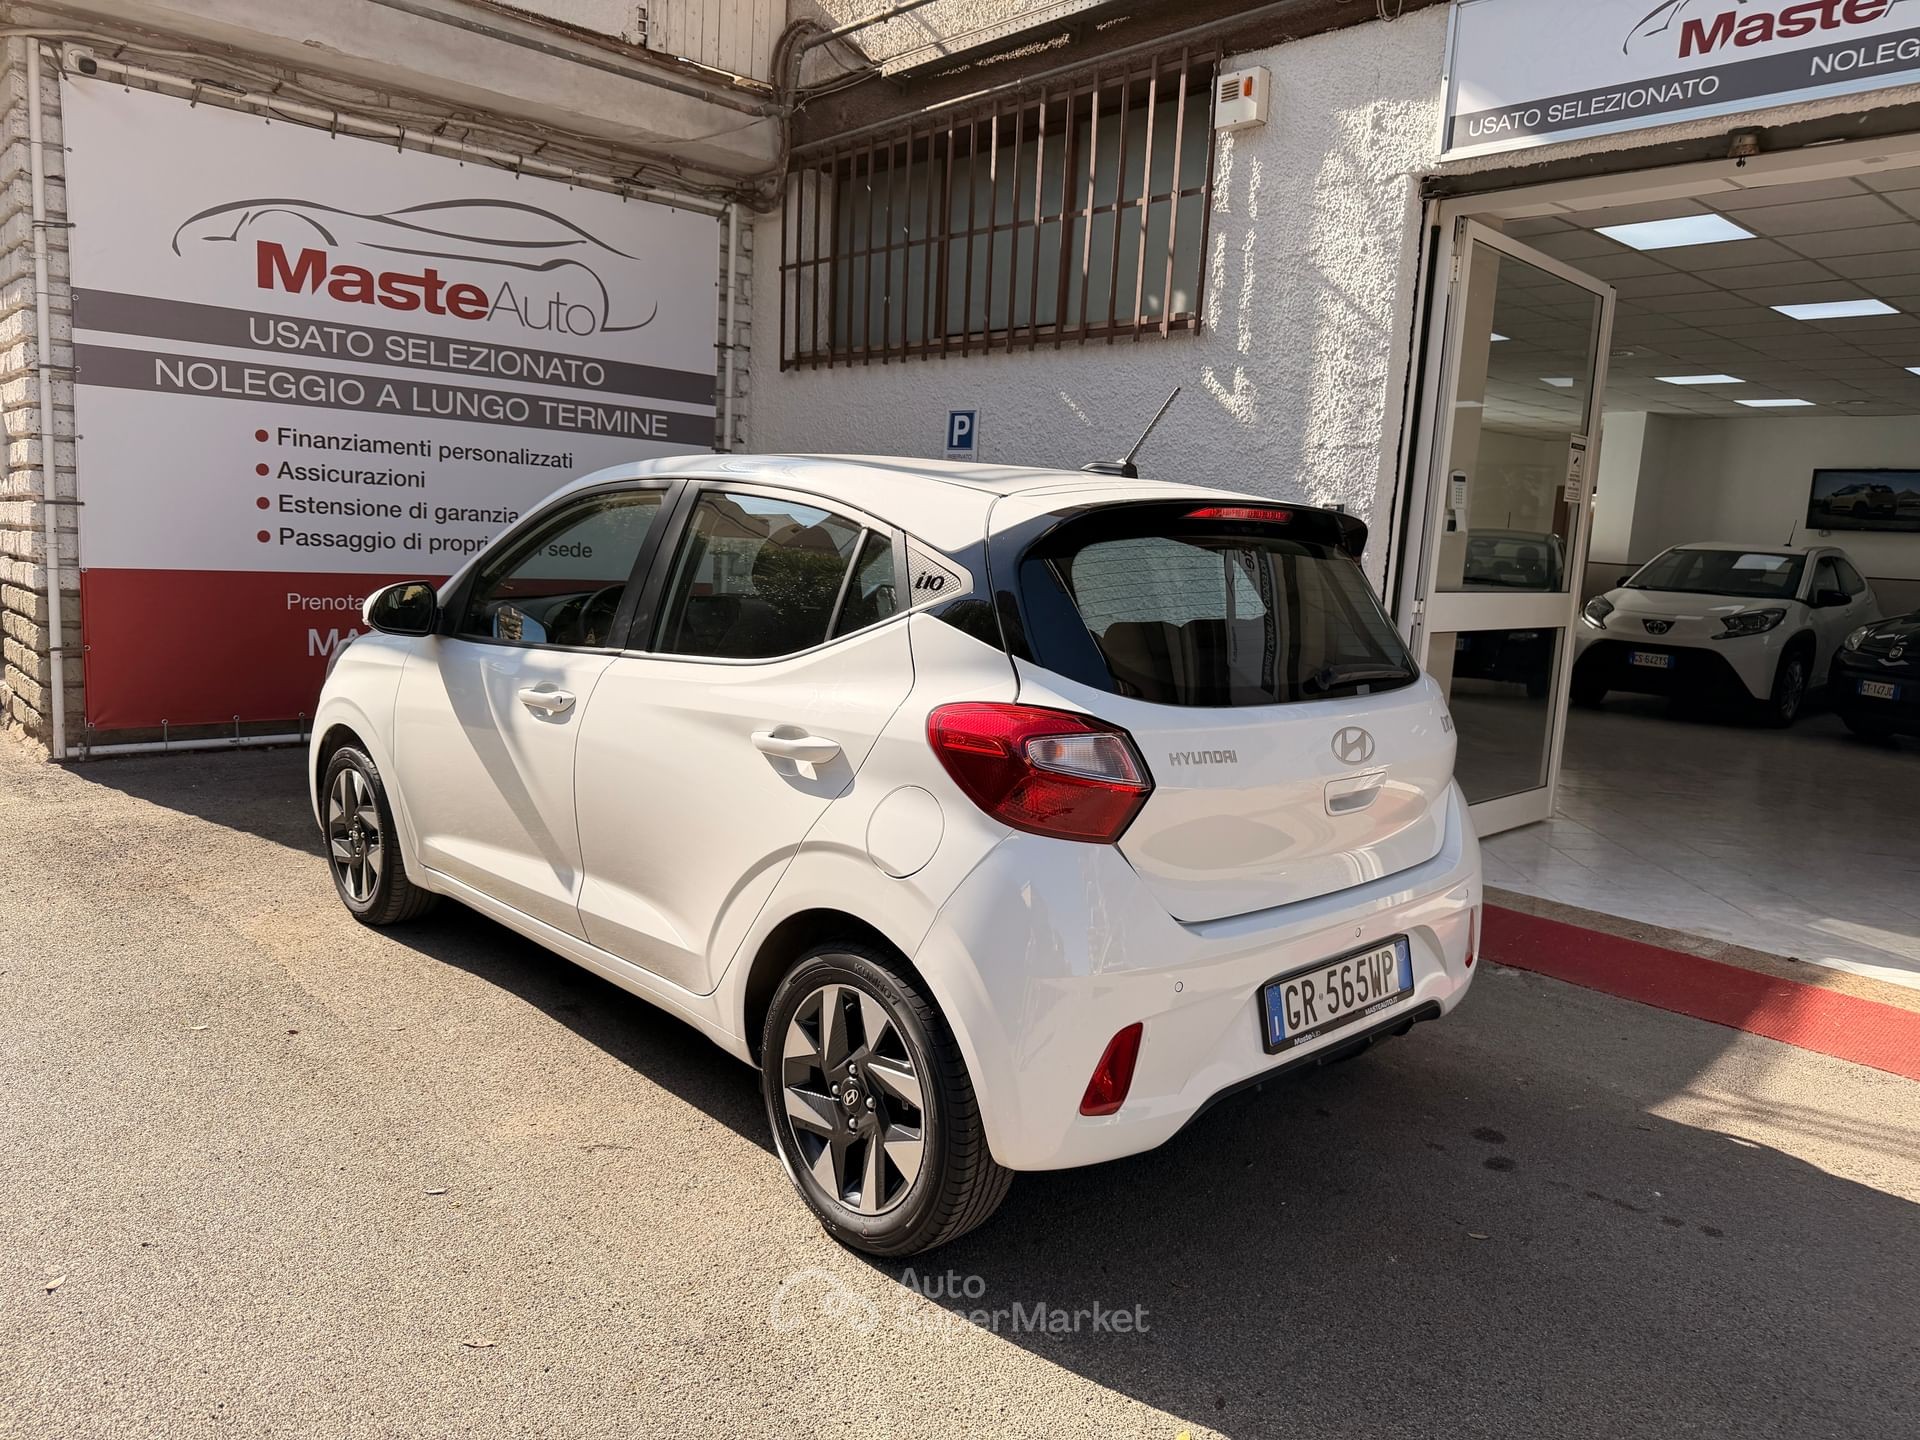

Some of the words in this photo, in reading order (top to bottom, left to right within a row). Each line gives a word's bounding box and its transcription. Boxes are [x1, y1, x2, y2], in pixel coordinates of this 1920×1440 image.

[1678, 0, 1894, 58] Maste
[1809, 38, 1920, 76] NOLEG
[1468, 109, 1541, 137] USATO
[1547, 75, 1721, 123] SELEZIONATO
[256, 239, 598, 337] MasteAuto
[248, 317, 375, 358] USATO
[384, 333, 606, 387] SELEZIONATO
[154, 358, 366, 406] NOLEGGIO
[376, 384, 402, 410] A
[412, 387, 530, 424] LUNGO
[538, 402, 669, 438] TERMINE
[277, 427, 432, 458] Finanziamenti
[438, 442, 574, 469] personalizzati
[952, 415, 970, 446] P
[277, 461, 426, 488] Assicurazioni
[278, 494, 402, 519] Estensione
[408, 498, 428, 519] di
[434, 503, 519, 524] garanzia
[279, 527, 396, 552] Passaggio
[403, 532, 422, 550] di
[428, 536, 489, 555] propri
[548, 542, 593, 558] sede
[915, 571, 945, 591] i10
[287, 592, 365, 611] Prenota
[1168, 749, 1238, 766] HYUNDAI
[1285, 979, 1318, 1030] GR
[1326, 950, 1394, 1014] 565WP
